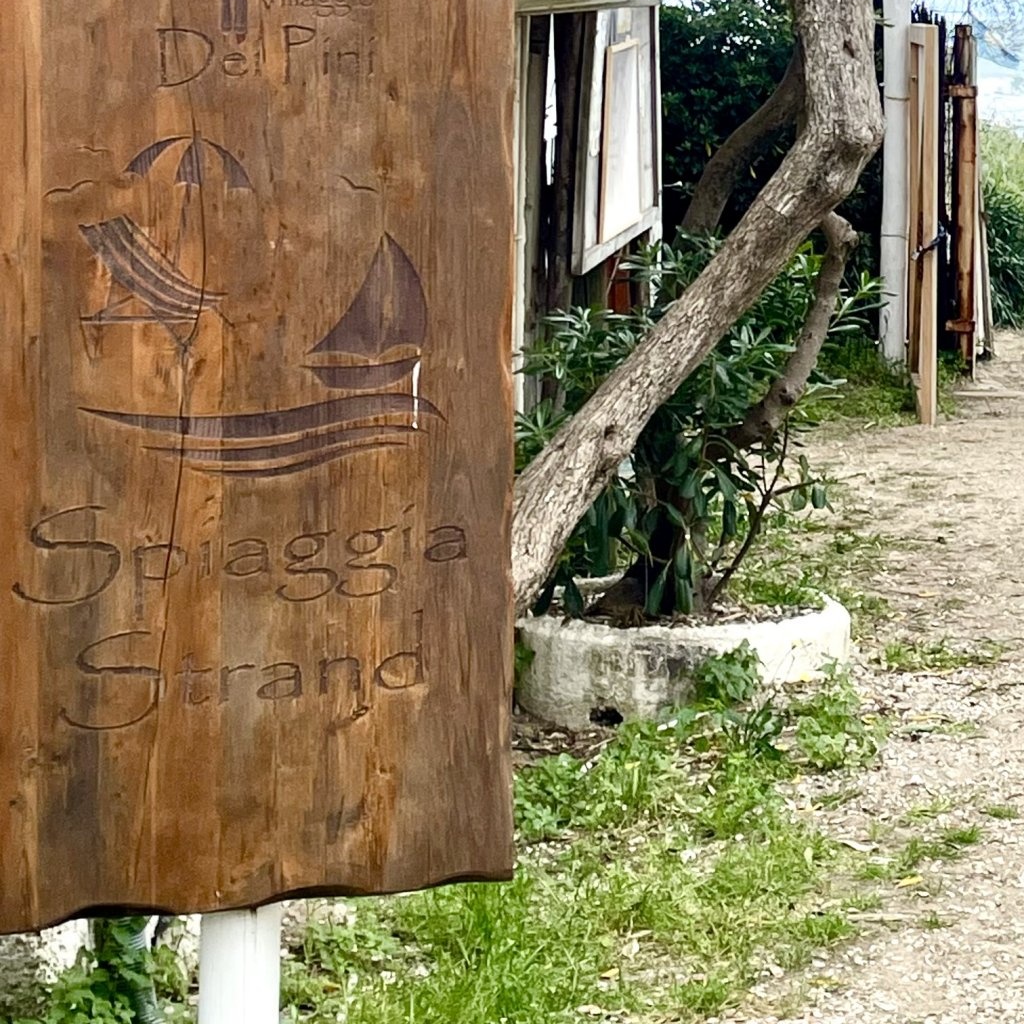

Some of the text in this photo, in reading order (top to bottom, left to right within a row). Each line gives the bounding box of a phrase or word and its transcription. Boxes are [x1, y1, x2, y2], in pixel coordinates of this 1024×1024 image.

[282, 24, 376, 85] Pini
[11, 504, 468, 621] Spiaggia
[58, 609, 428, 730] Strand
